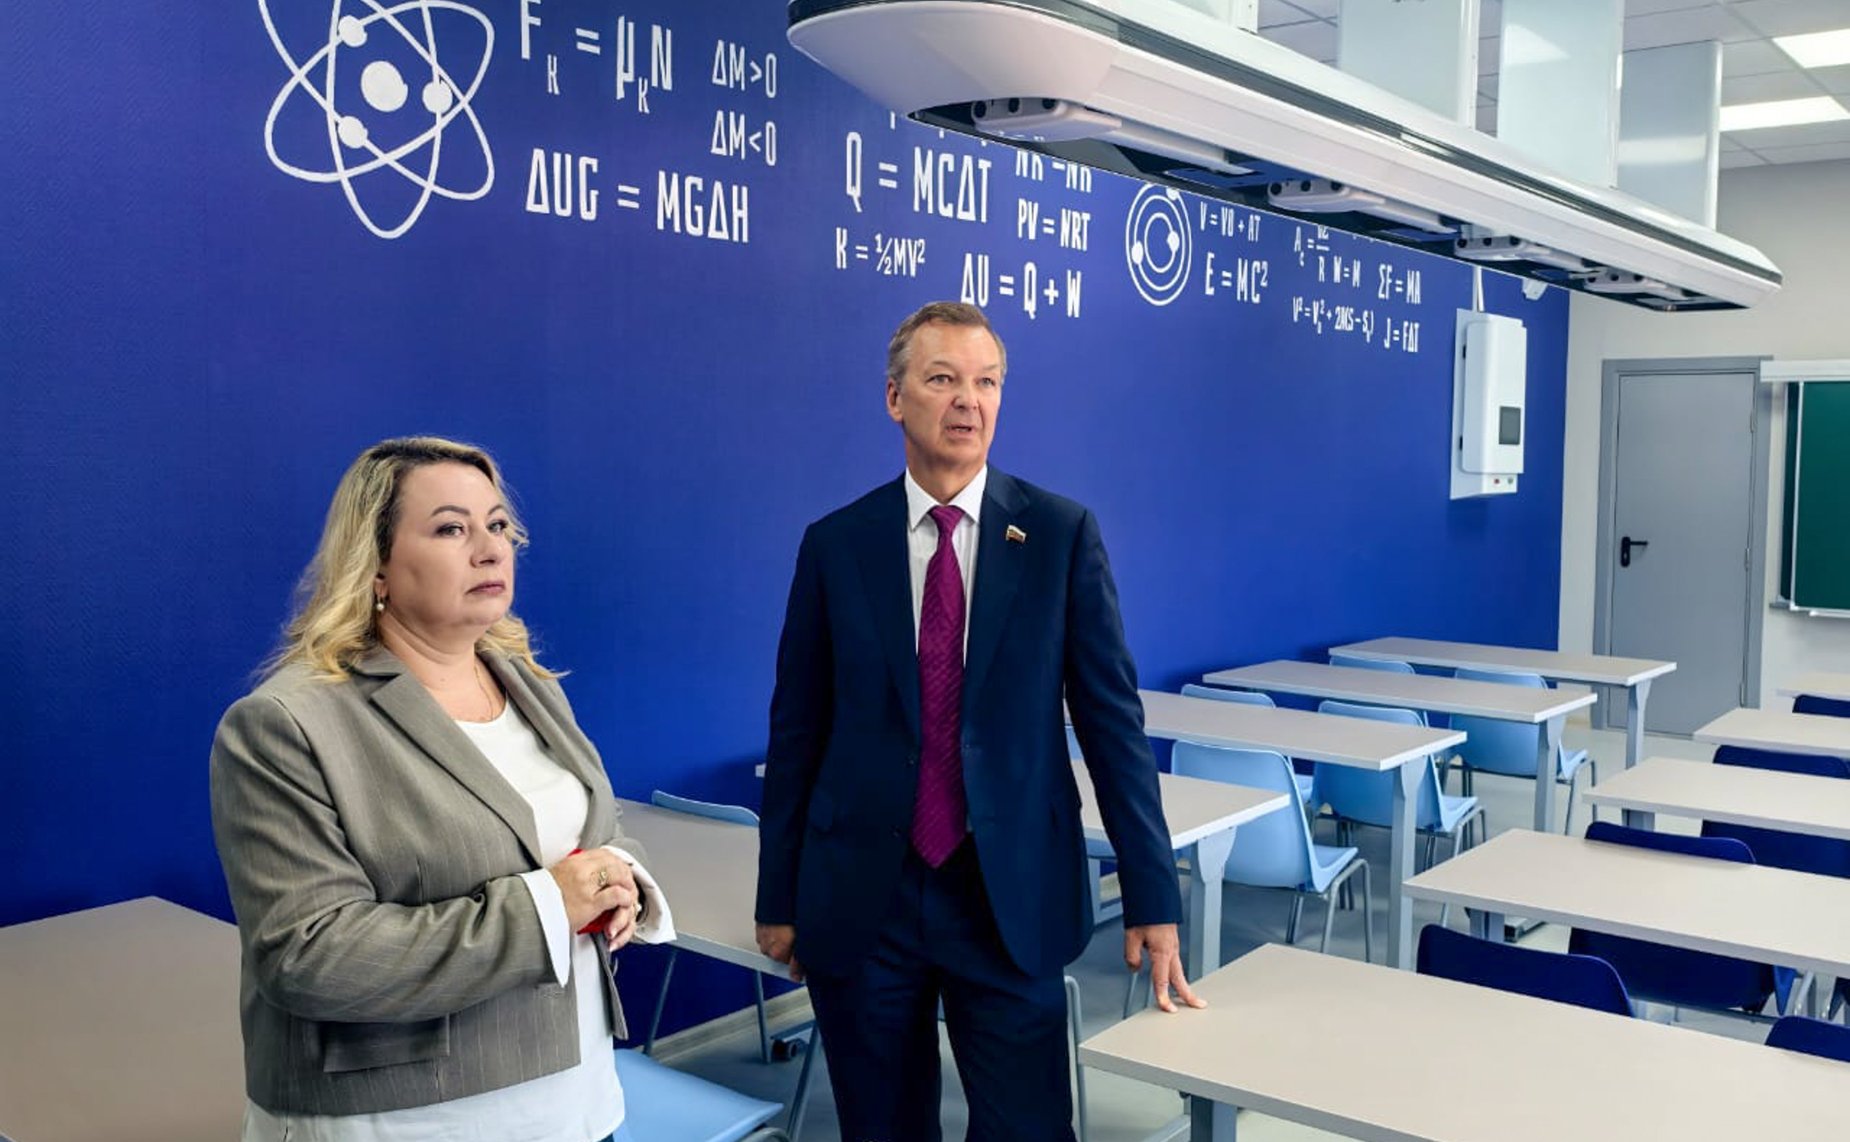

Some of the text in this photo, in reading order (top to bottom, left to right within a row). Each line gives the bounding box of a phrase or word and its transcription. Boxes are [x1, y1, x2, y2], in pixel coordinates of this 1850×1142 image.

[845, 131, 862, 213] Q
[836, 227, 848, 269] K
[1018, 197, 1039, 241] PV
[1060, 207, 1091, 252] NRT
[1023, 261, 1037, 319] Q
[1067, 269, 1082, 318] W
[1204, 251, 1215, 296] E
